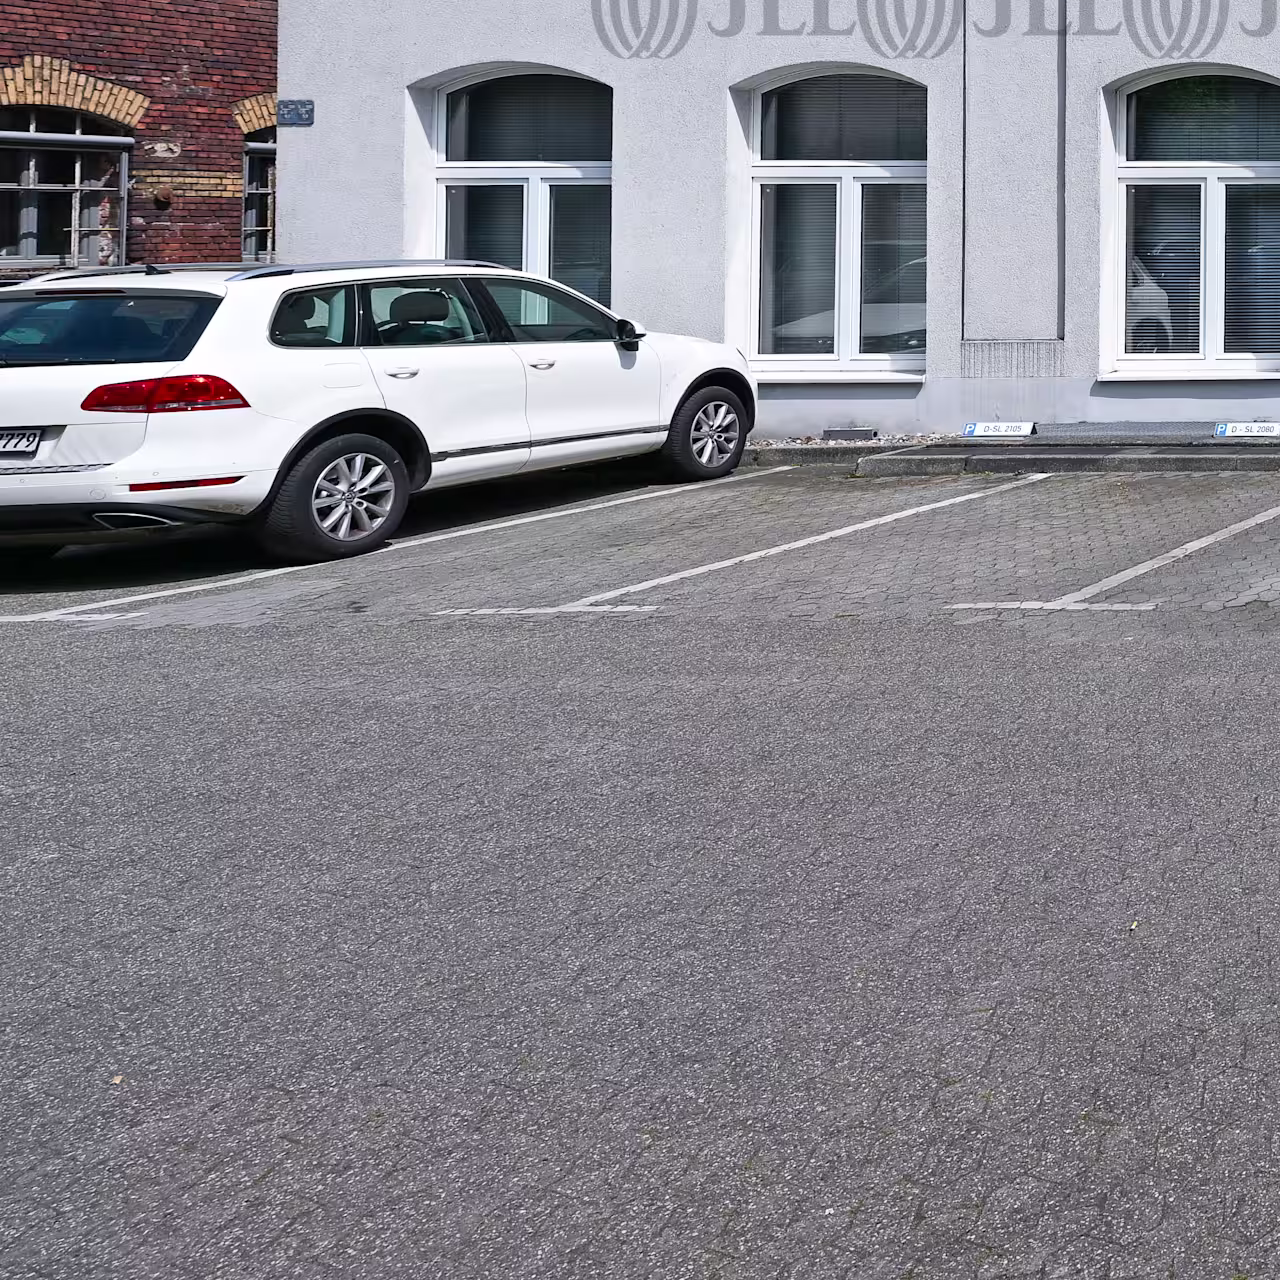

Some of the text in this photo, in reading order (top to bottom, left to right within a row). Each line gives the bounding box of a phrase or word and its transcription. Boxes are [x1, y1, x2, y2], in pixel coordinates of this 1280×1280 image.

[964, 424, 975, 435] P
[1004, 425, 1022, 433] 2105
[1216, 424, 1226, 435] P
